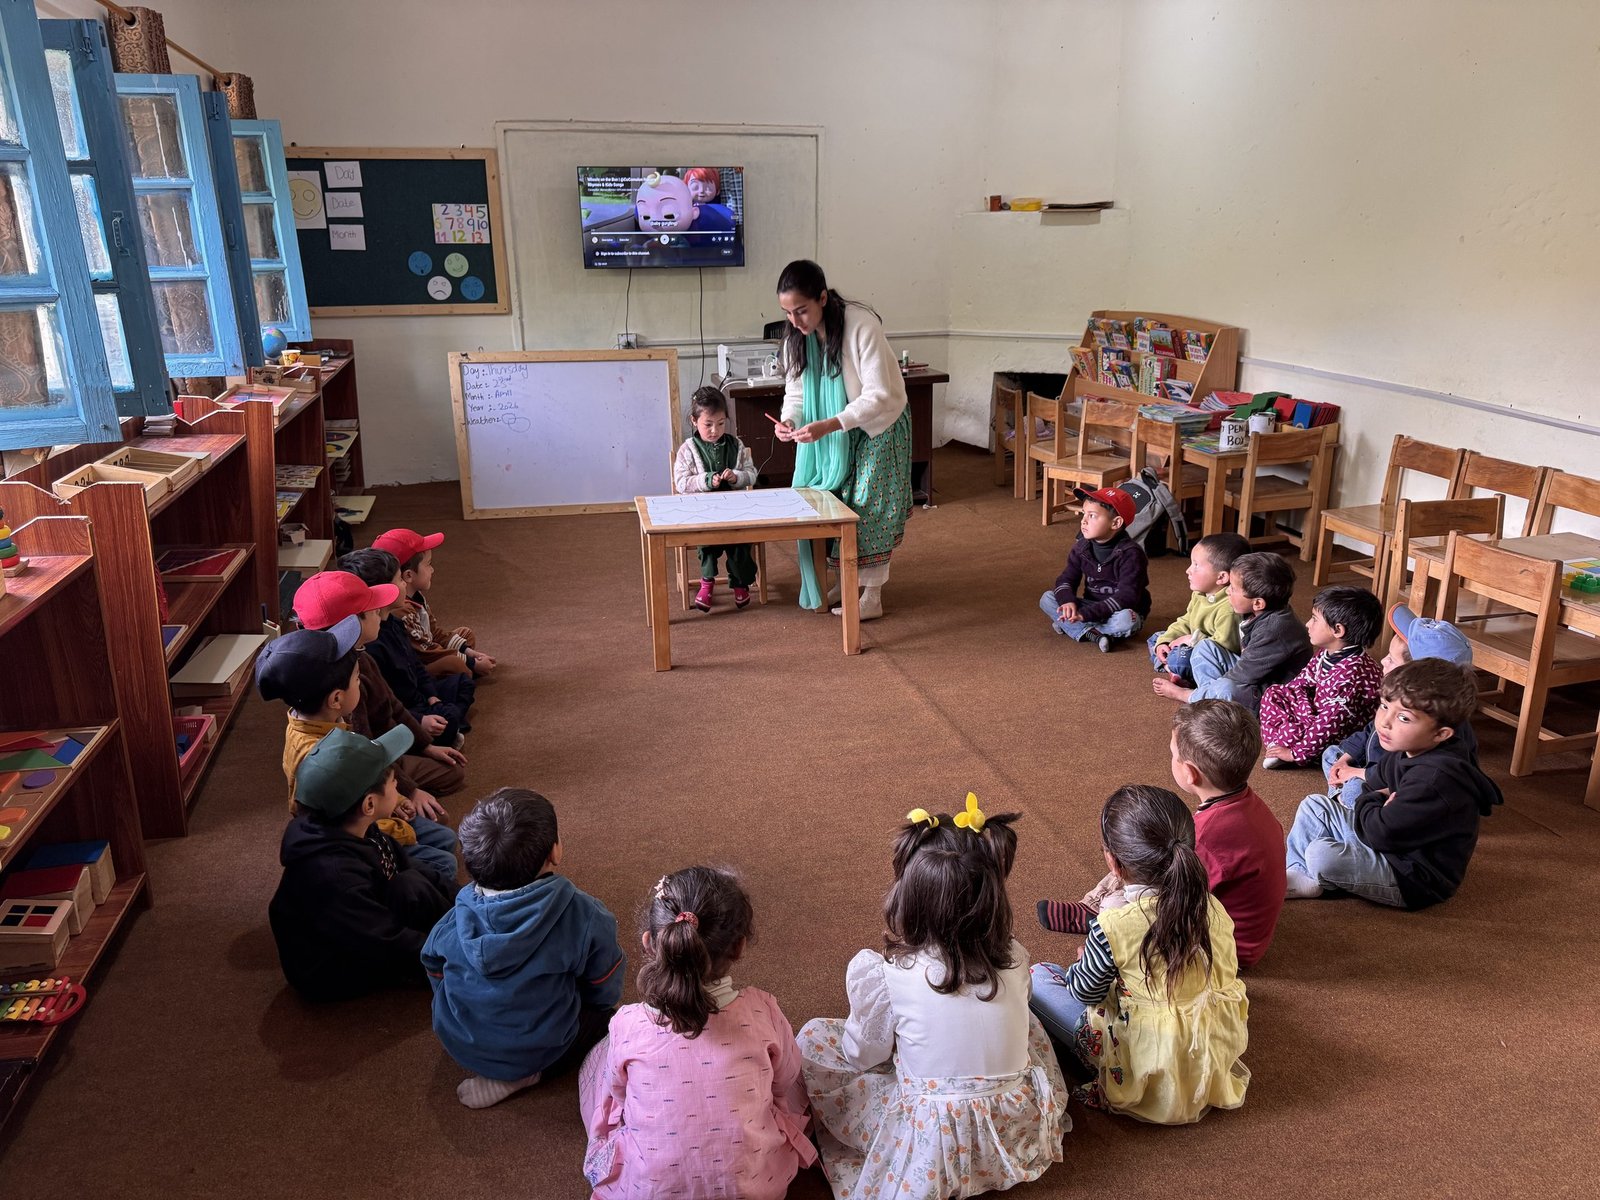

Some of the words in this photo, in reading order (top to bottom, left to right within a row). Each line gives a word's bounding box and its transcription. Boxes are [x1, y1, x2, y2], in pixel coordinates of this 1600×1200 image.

[334, 165, 355, 181] Day
[331, 196, 354, 210] Date
[440, 204, 450, 215] 2
[454, 204, 463, 217] 3
[464, 204, 474, 218] 4
[476, 205, 486, 219] 5
[445, 217, 455, 230] 7
[456, 217, 465, 229] 8
[466, 218, 475, 232] 9
[477, 219, 488, 230] 10
[331, 230, 357, 240] Month
[452, 230, 466, 243] 12
[471, 231, 484, 243] 13
[462, 364, 480, 379] Day
[465, 381, 483, 391] Date
[464, 392, 484, 401] Month
[494, 389, 513, 399] April
[468, 404, 484, 412] Year
[1228, 423, 1245, 435] PEN
